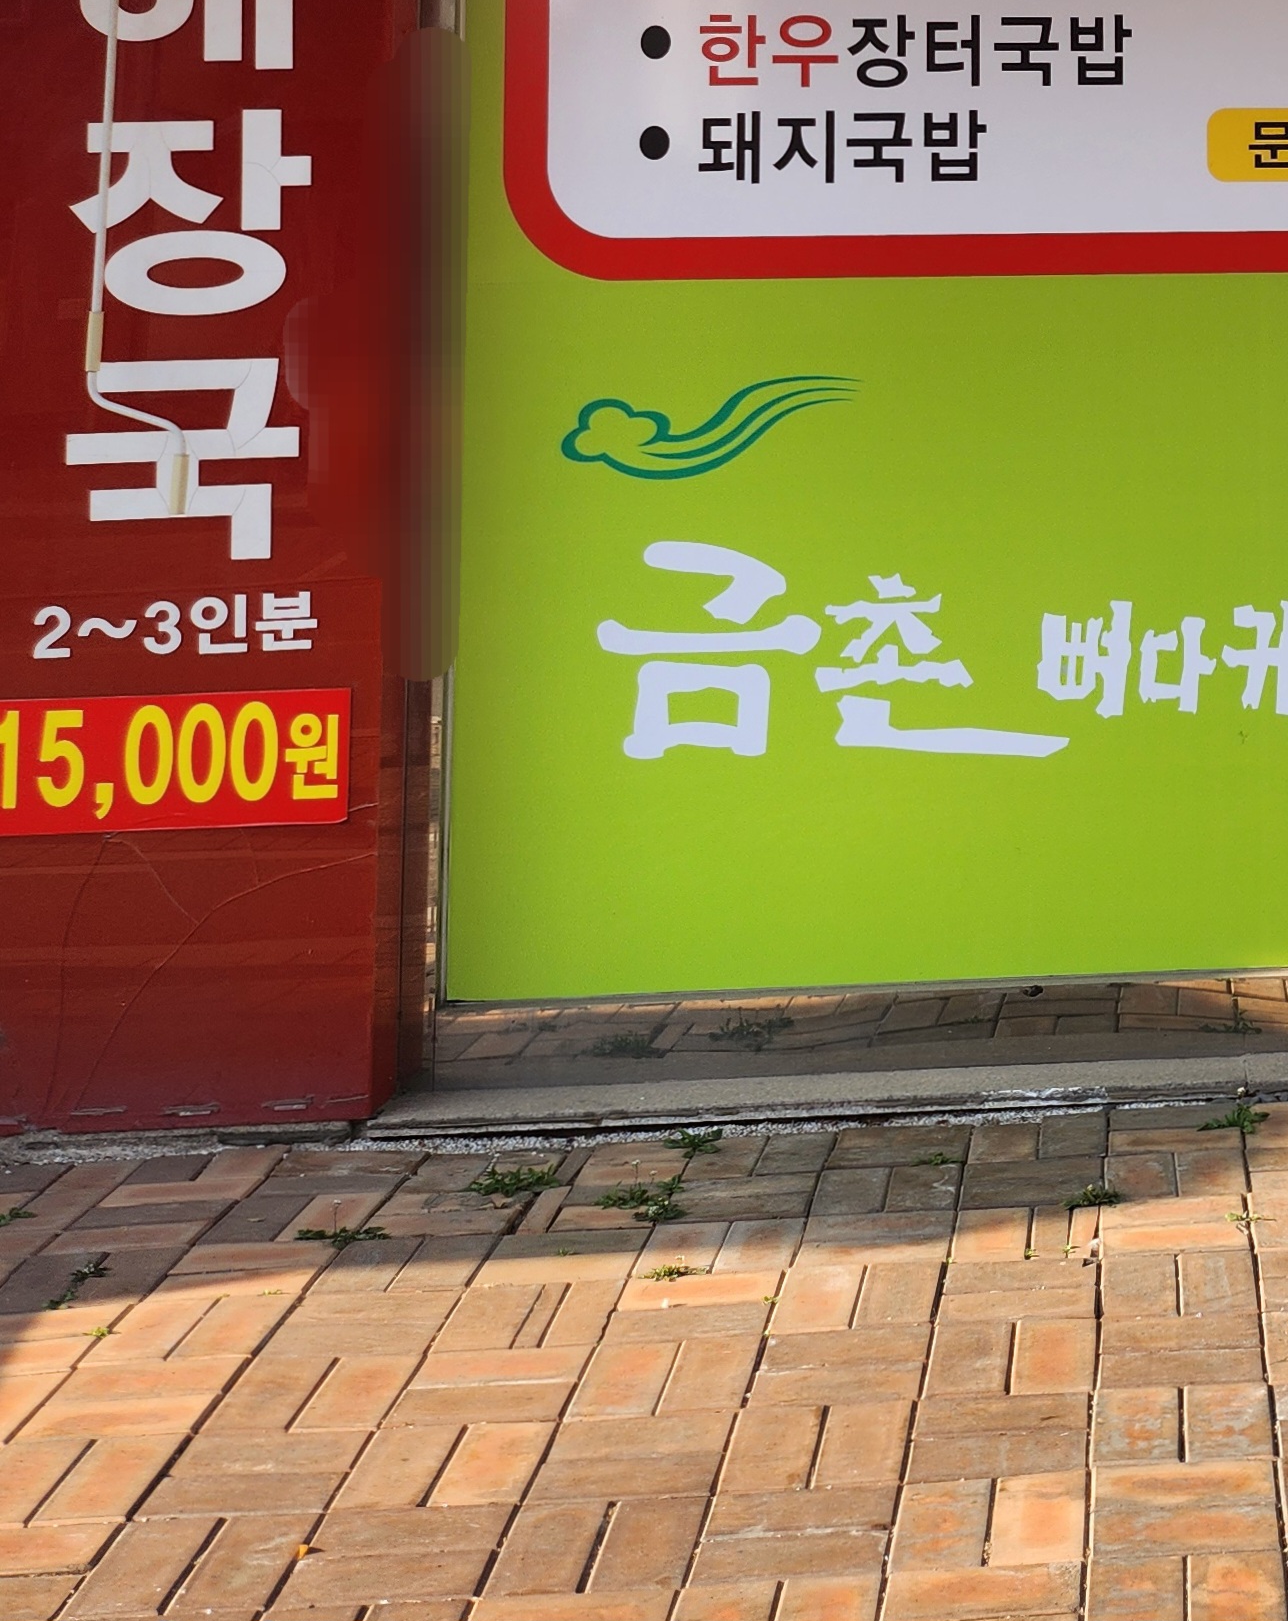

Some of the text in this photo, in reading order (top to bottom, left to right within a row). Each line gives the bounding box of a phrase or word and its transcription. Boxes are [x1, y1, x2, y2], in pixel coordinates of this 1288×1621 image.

[699, 14, 1133, 88] 한우장터국밥
[698, 110, 988, 184] 돼지국밥
[33, 590, 319, 659] 2~3인분
[597, 540, 1070, 759] 금촌
[0, 700, 339, 820] 15,000원
